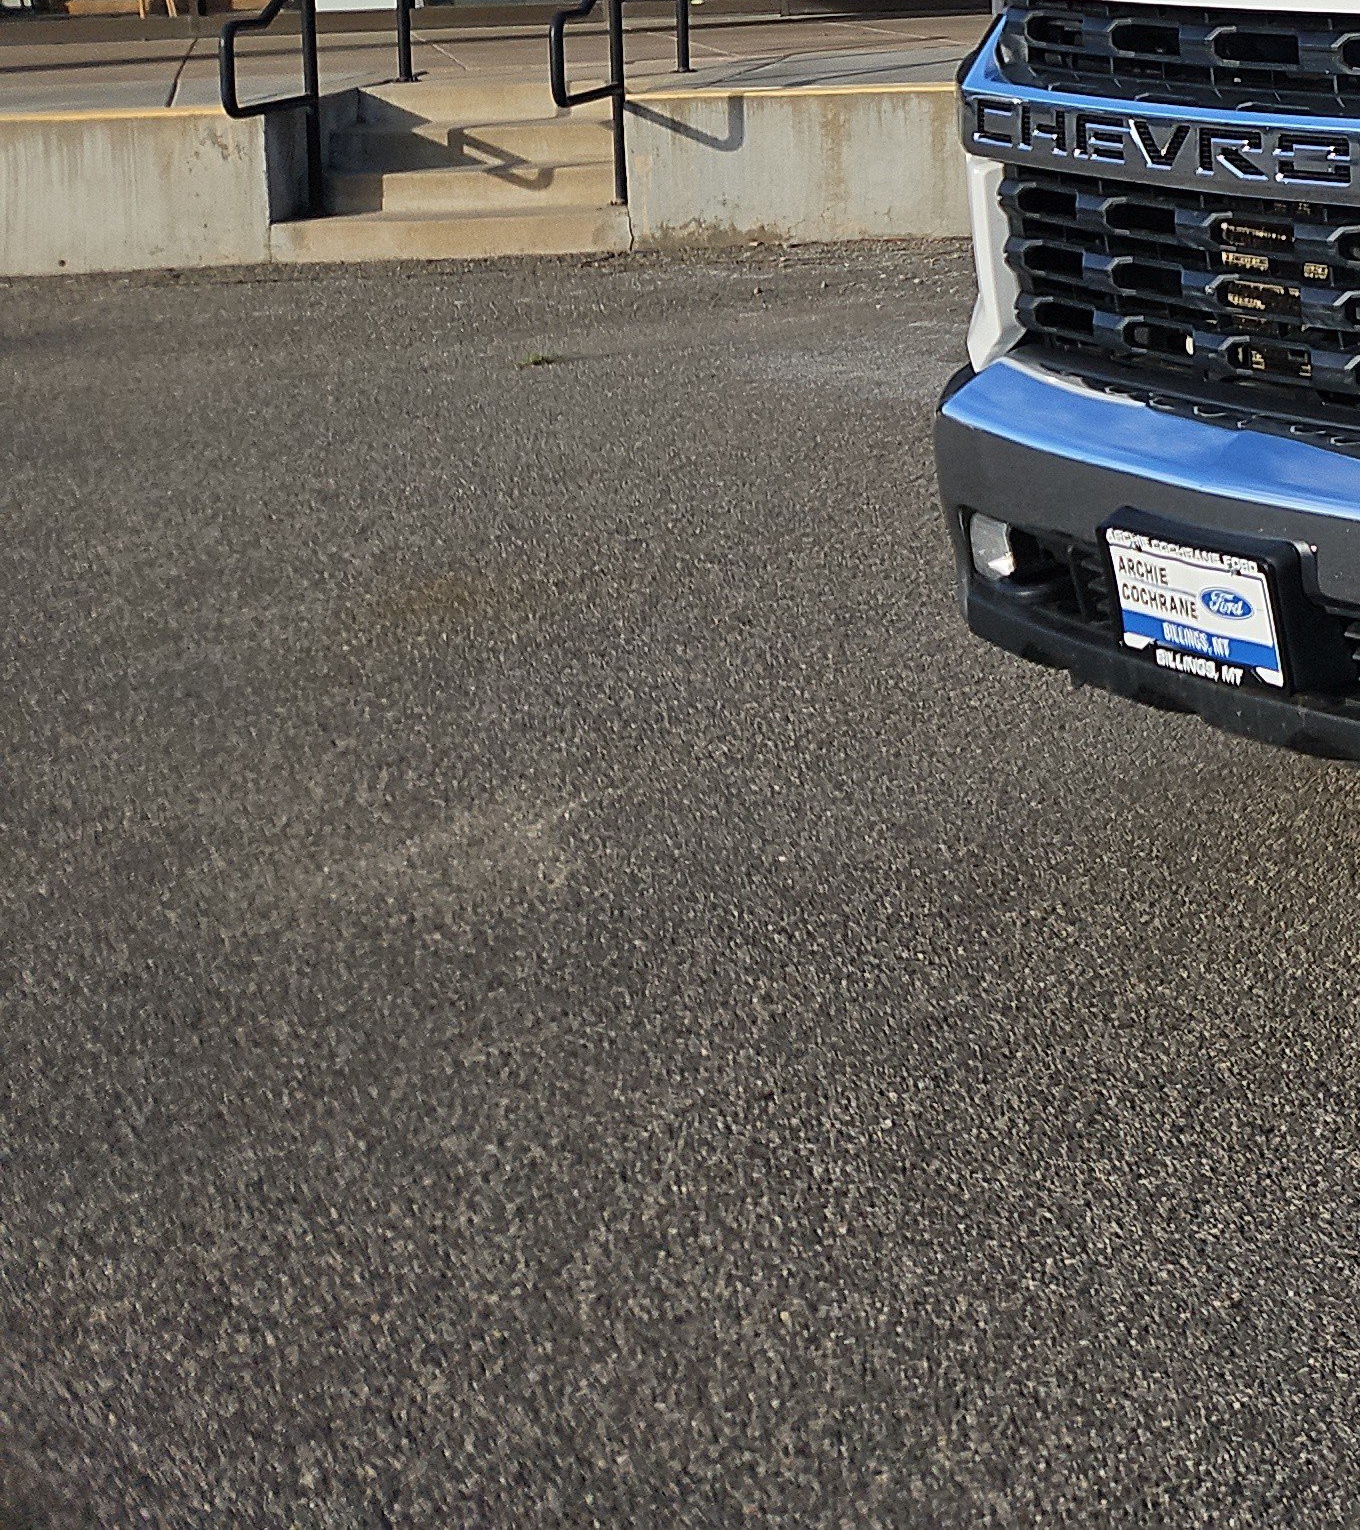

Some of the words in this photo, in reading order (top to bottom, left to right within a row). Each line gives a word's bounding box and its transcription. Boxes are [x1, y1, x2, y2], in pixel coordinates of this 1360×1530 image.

[1151, 539, 1221, 565] COCHRANE
[1118, 555, 1168, 586] ARCHIE
[1122, 582, 1198, 620] COCHRANE
[1209, 590, 1243, 616] Ford
[1162, 622, 1212, 656] BILLINGS,
[1212, 635, 1230, 658] MT
[1156, 649, 1219, 682] BILLINGS,
[1222, 665, 1244, 687] MT
